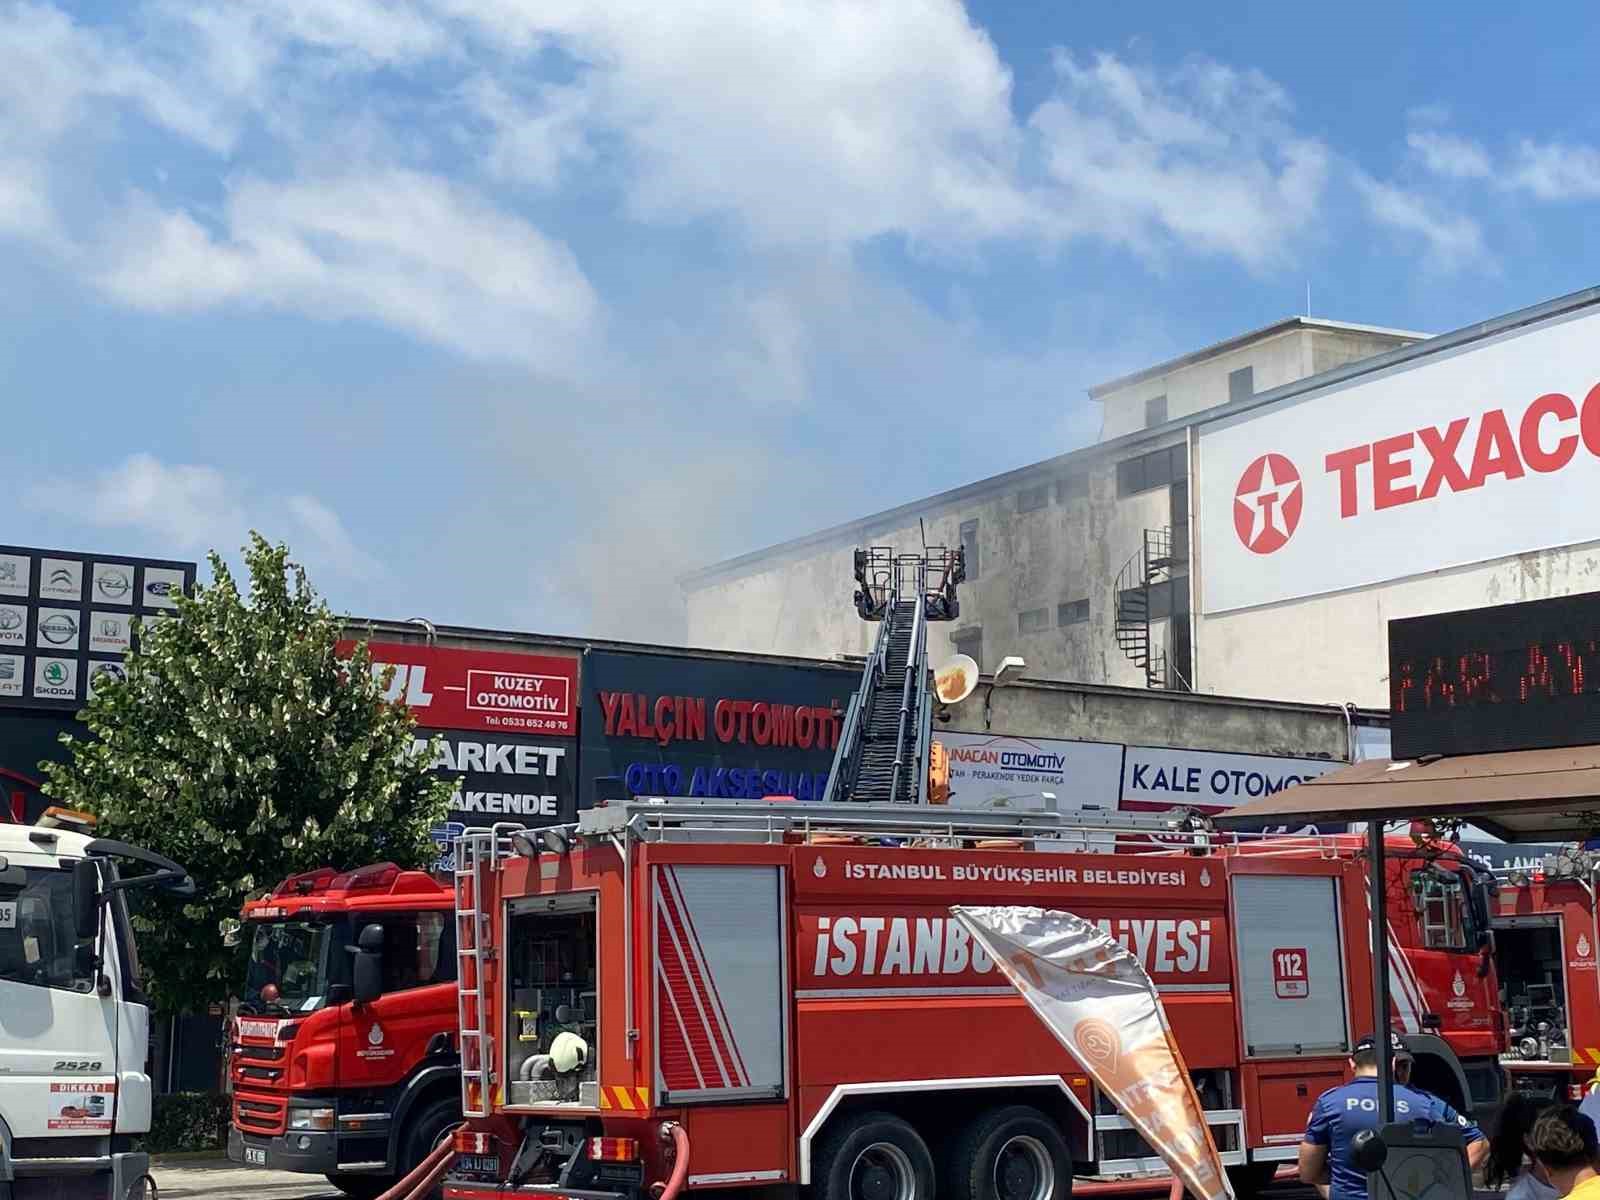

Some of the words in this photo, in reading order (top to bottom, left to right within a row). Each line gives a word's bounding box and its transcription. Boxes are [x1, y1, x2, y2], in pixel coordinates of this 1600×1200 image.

[494, 676, 543, 692] KUZEY
[477, 692, 559, 710] OTOMOTİV
[502, 717, 525, 727] 0533
[526, 718, 543, 728] 652
[544, 720, 556, 729] 48
[599, 691, 704, 746] YALÇIN
[714, 698, 841, 749] OTOMOTİ
[1001, 752, 1065, 769] OTOMOTİV
[625, 762, 682, 794] OTO
[1132, 763, 1201, 793] KALE
[845, 860, 947, 880] İSTANBUL
[952, 866, 1077, 886] BÜYÜKŞEHİR
[1083, 869, 1186, 886] BELEDİYESİ
[1278, 953, 1303, 977] 112
[1346, 1098, 1410, 1113] POS
